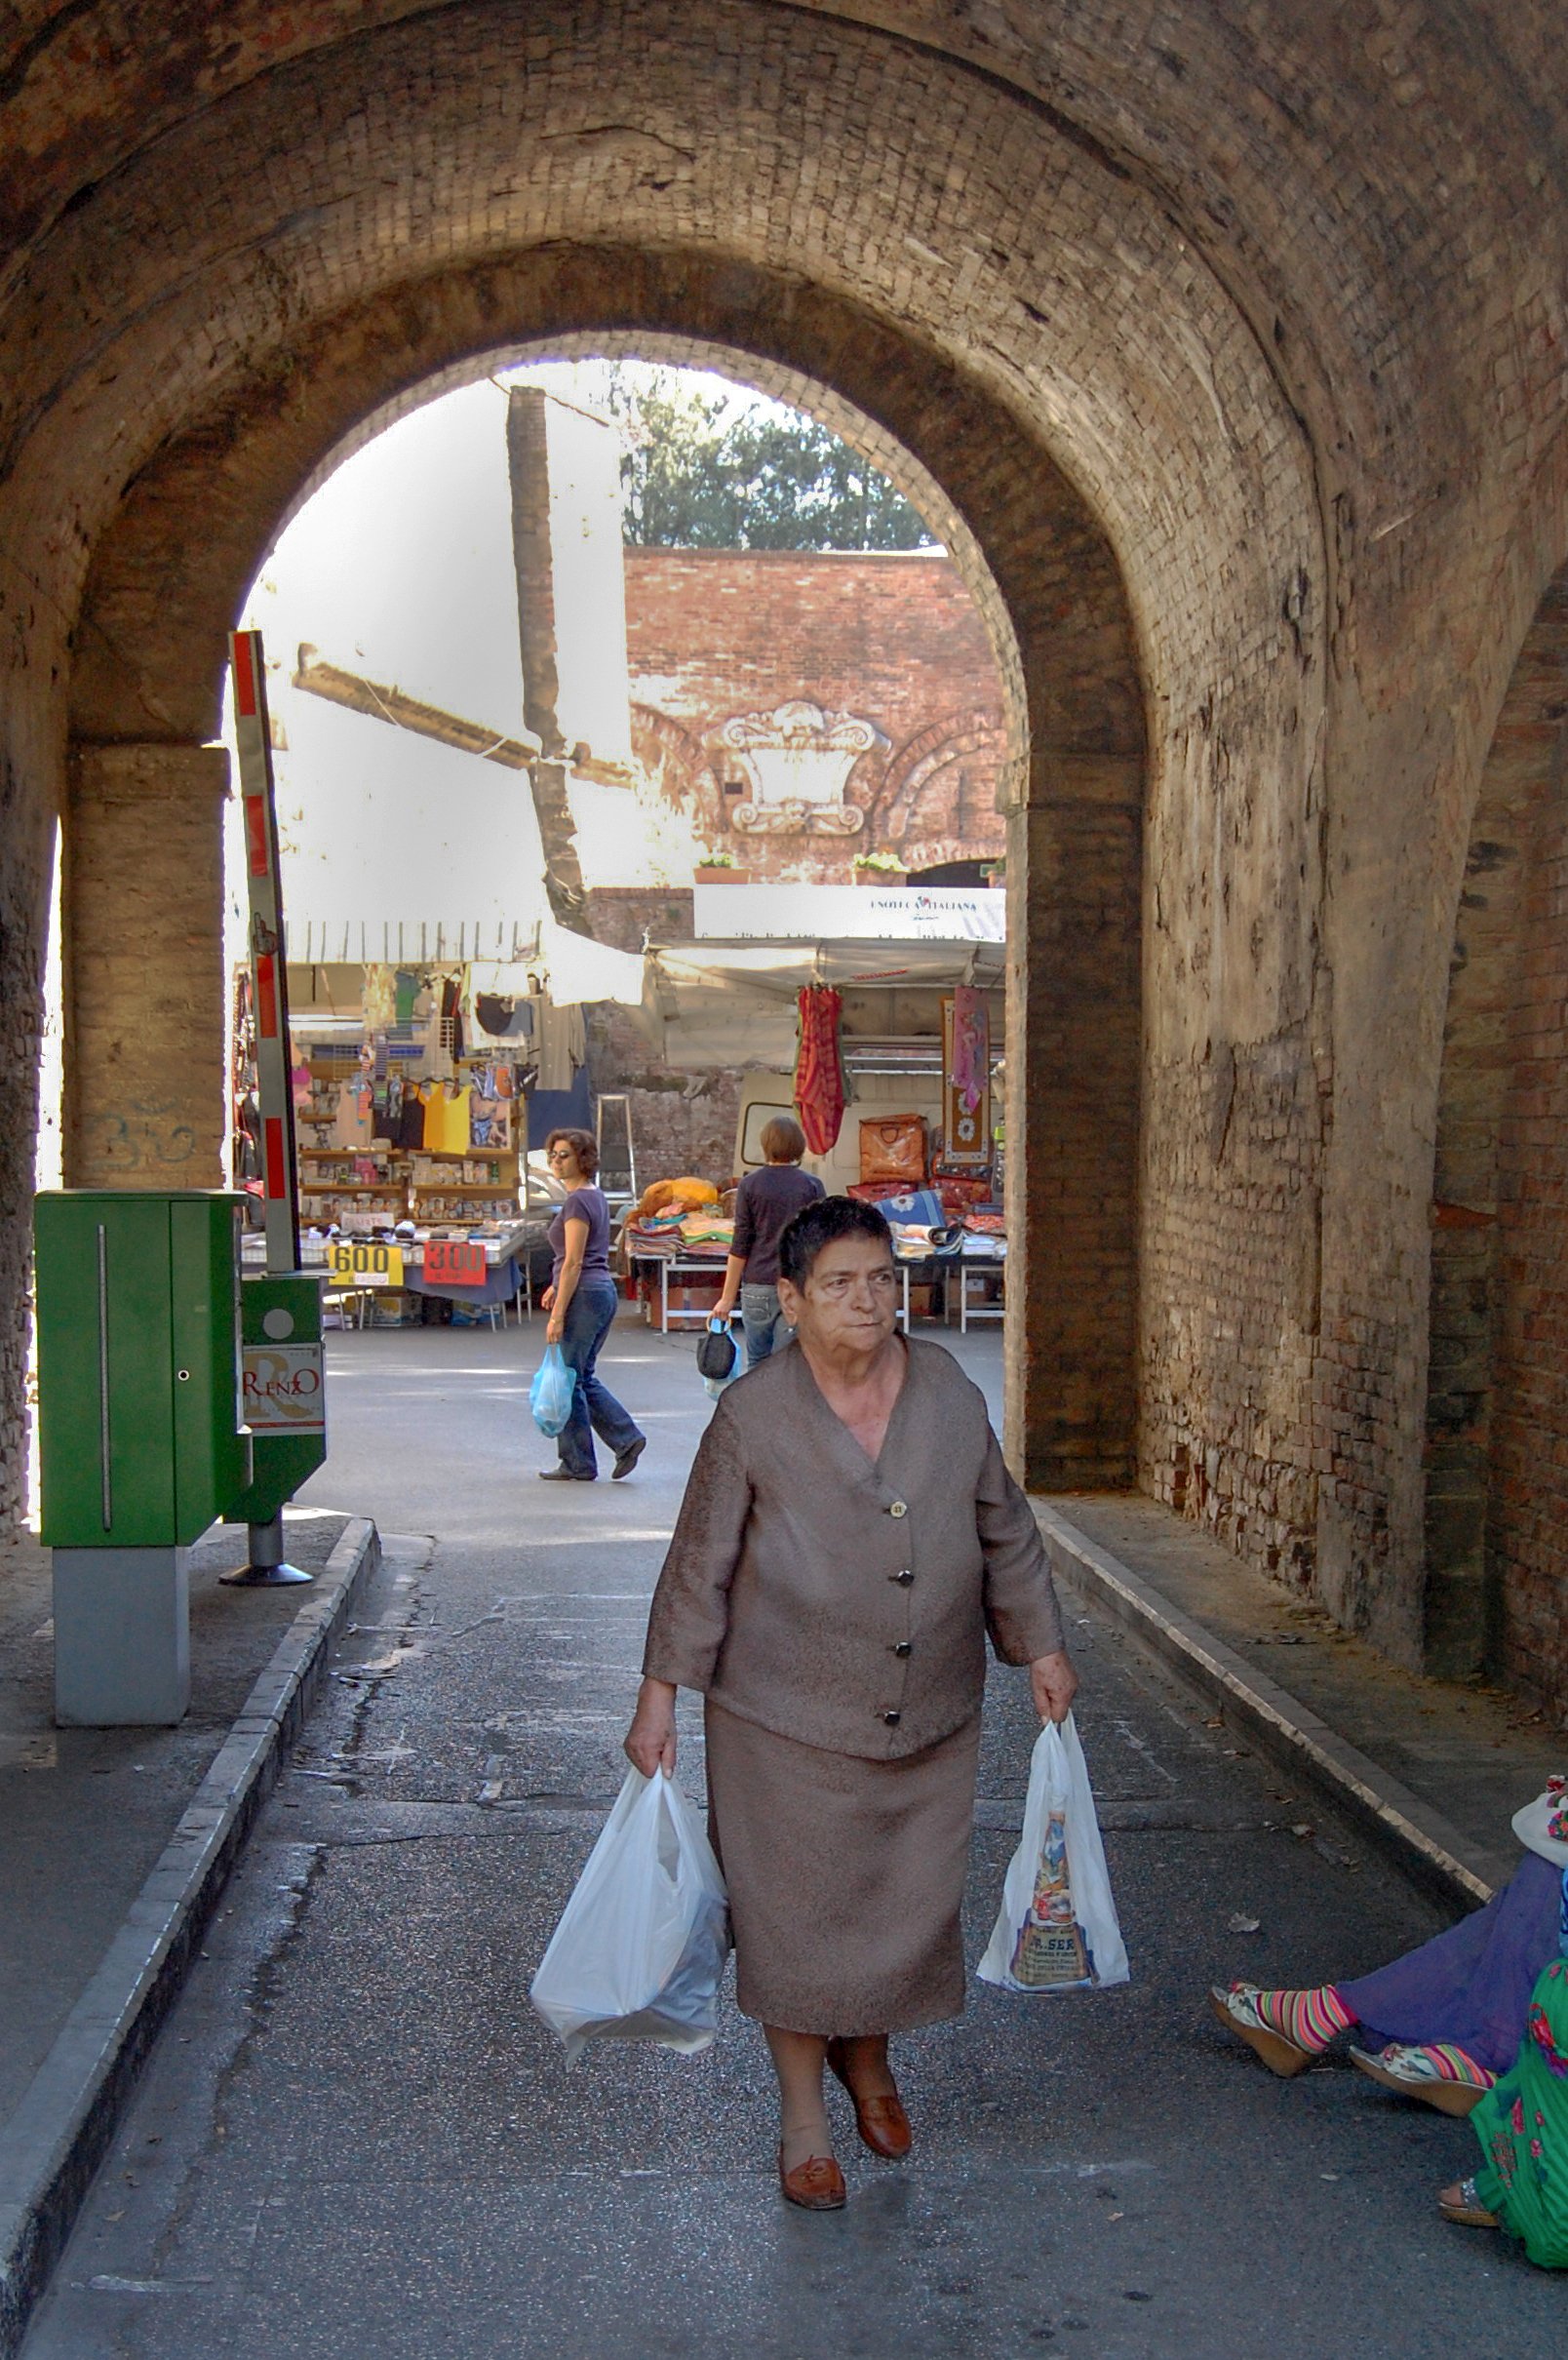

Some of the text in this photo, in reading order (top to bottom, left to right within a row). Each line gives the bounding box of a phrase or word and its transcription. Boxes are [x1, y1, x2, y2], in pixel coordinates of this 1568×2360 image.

[871, 899, 977, 912] ENOTECA ITALIANA
[334, 1246, 389, 1273] 600
[429, 1243, 482, 1272] 300
